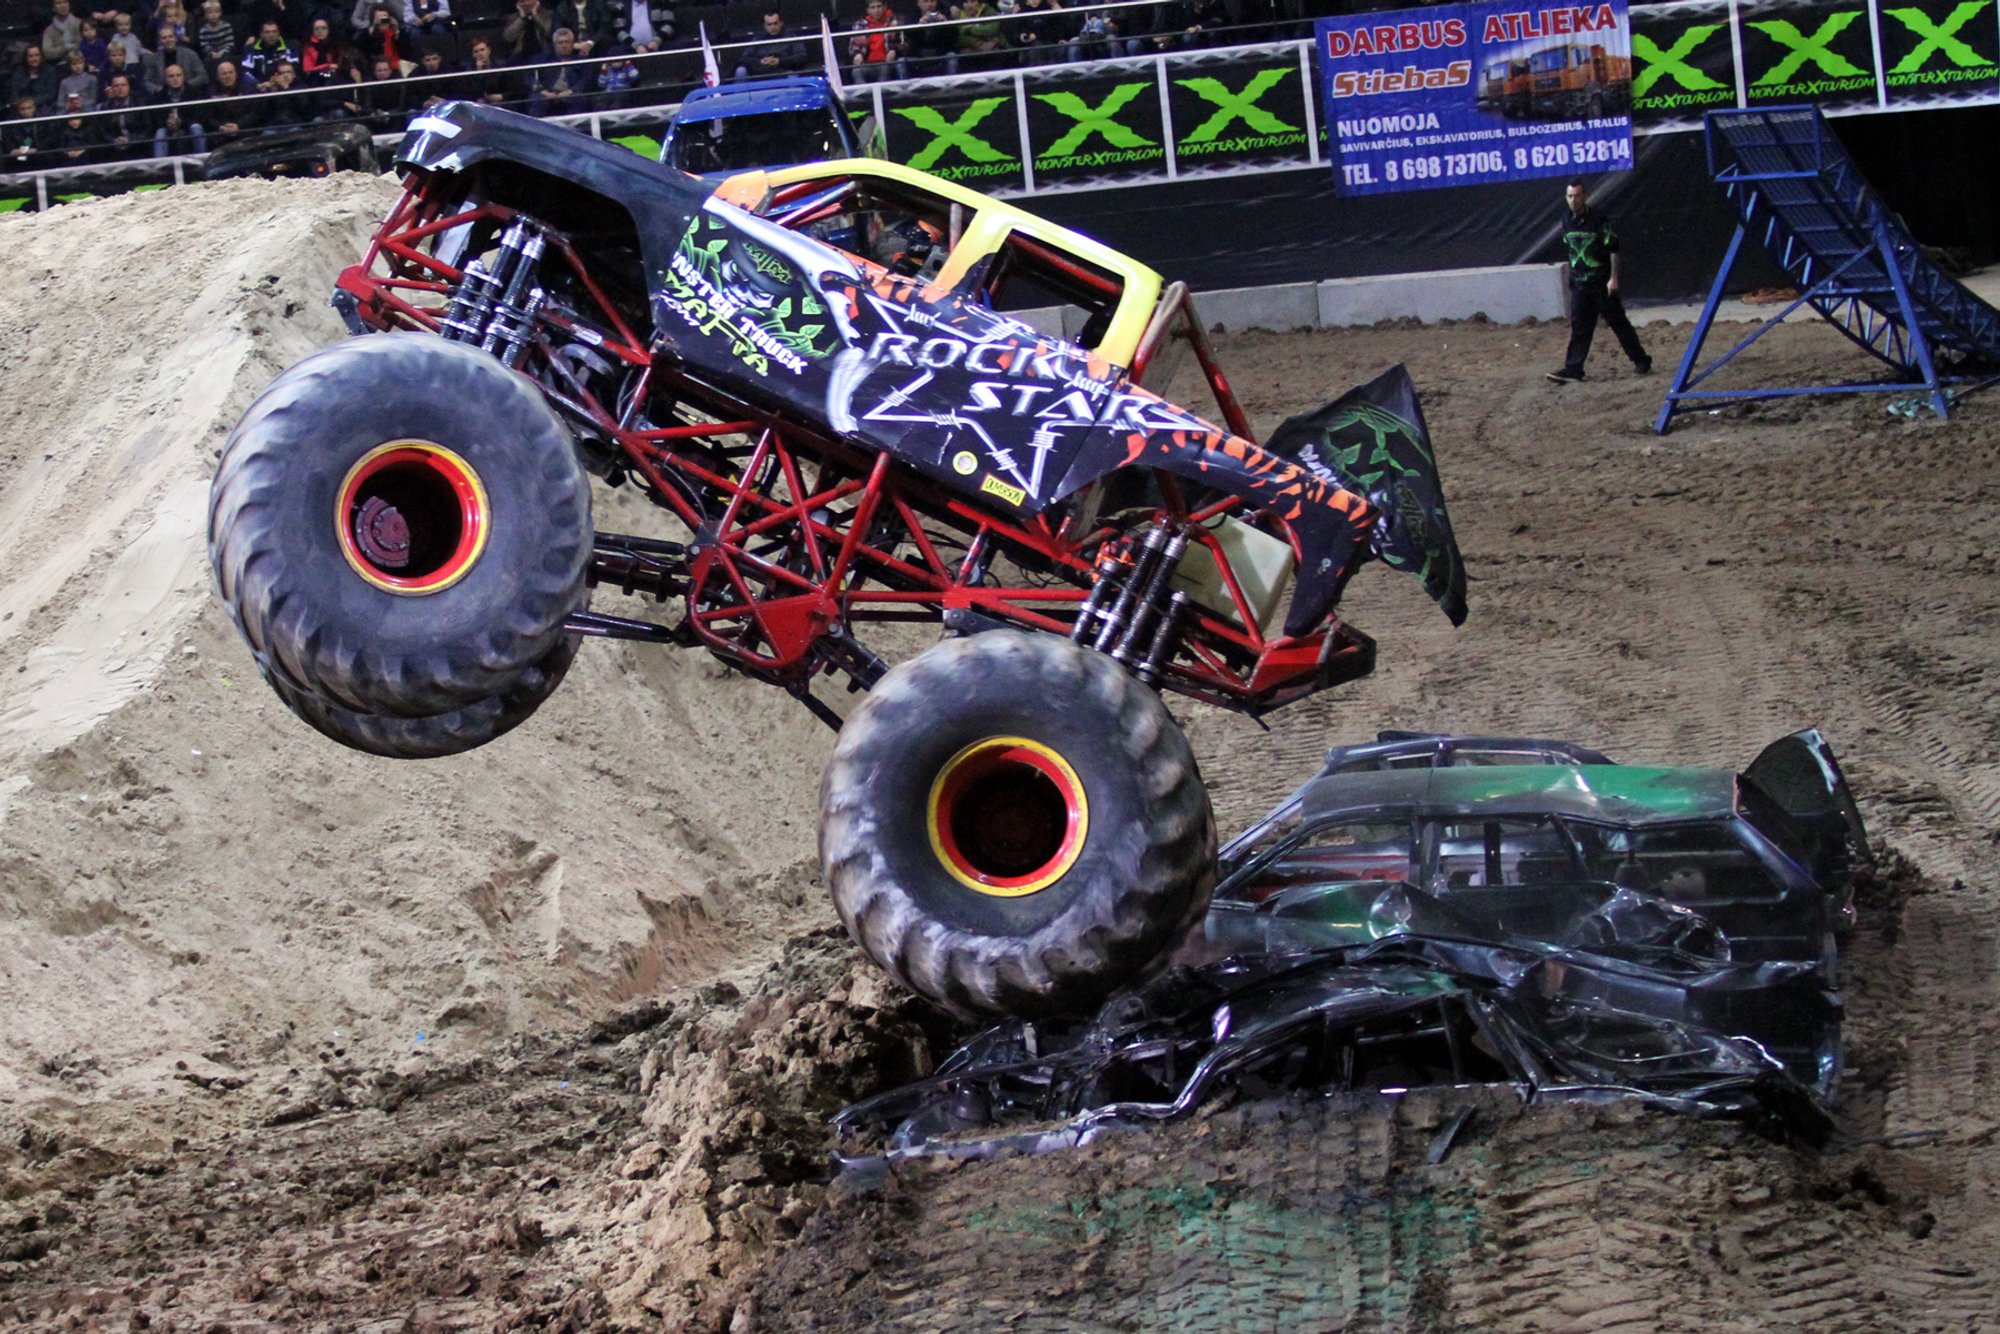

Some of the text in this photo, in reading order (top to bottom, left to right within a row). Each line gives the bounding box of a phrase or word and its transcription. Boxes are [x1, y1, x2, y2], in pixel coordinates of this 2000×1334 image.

[1328, 3, 1618, 58] DARBUS ATLIEKA
[1333, 60, 1472, 98] StiebaS
[1337, 113, 1440, 138] NUOMOJA
[1339, 116, 1628, 153] SAVIVARČIUS, EKSKAVATORIUS, BULDOZERIUS, TRALUS
[1342, 138, 1630, 186] TEL. 8 698 73706, 8 620 52814
[740, 316, 808, 375] TRUCK
[867, 332, 1066, 380] ROCK
[962, 382, 1163, 438] STAR
